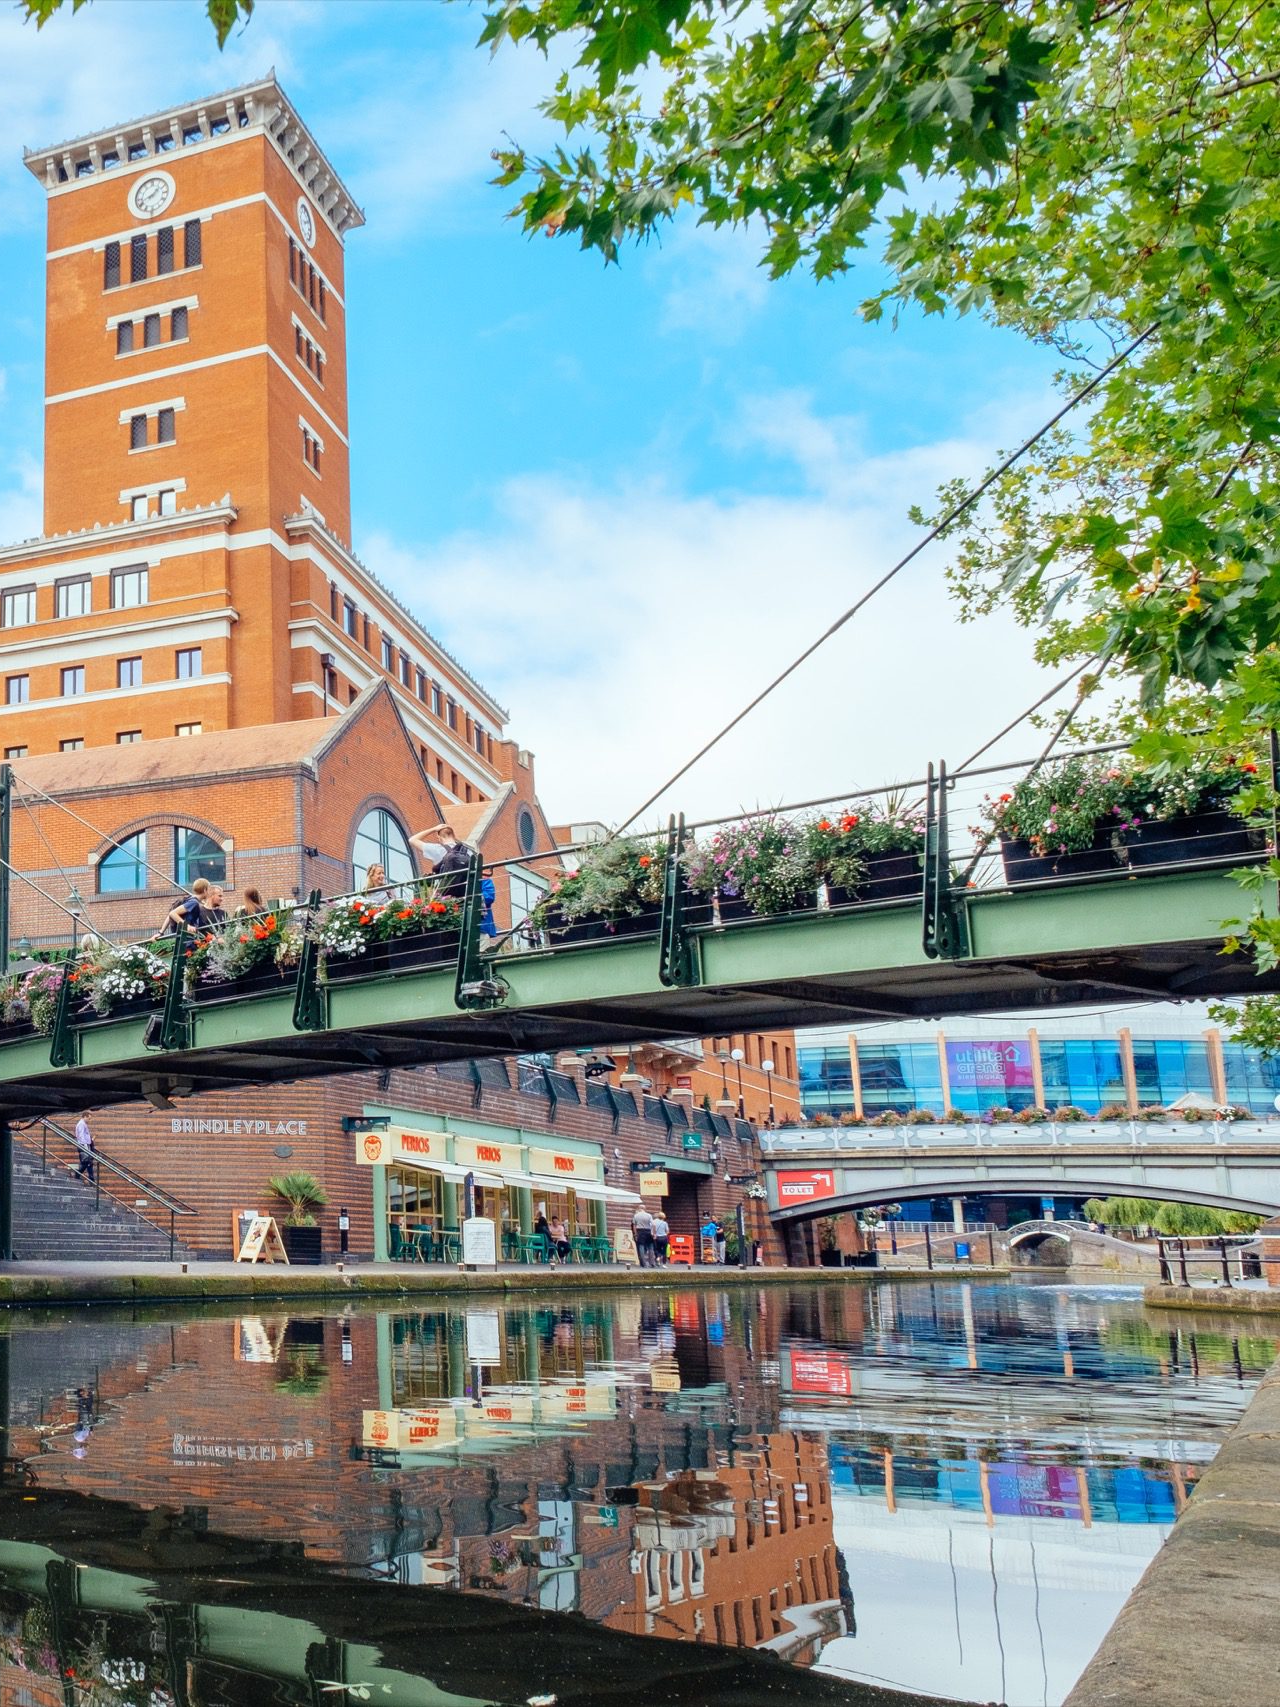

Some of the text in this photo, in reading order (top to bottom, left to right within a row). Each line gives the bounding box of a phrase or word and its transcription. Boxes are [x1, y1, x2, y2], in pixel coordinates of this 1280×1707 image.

[955, 1049, 1004, 1063] utilita
[957, 1062, 1006, 1074] arena
[171, 1118, 307, 1135] BRINDLEYPLACE
[401, 1134, 430, 1153] PERIOS
[476, 1145, 501, 1162] PERIOS
